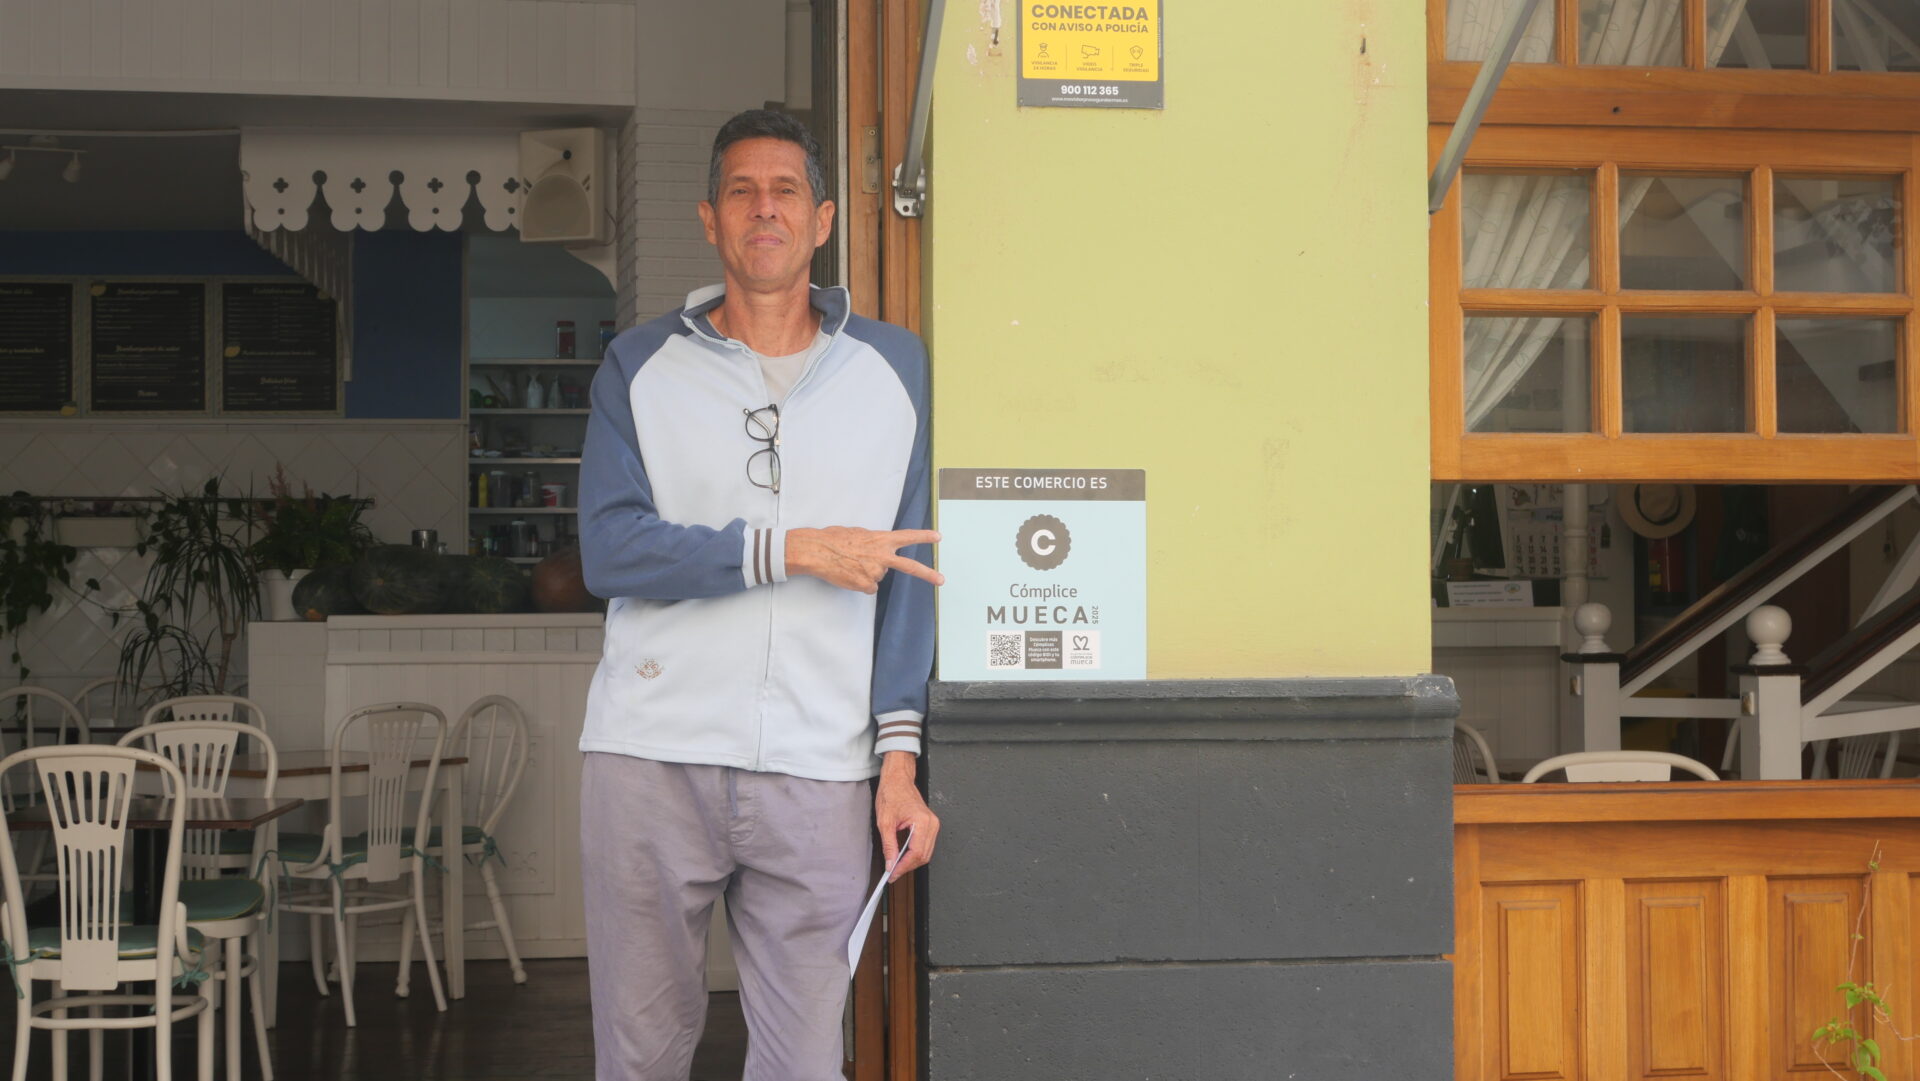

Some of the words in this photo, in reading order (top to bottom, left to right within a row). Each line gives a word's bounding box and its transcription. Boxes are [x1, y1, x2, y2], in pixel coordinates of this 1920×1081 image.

[1031, 4, 1149, 21] CONECTADA
[1031, 22, 1057, 31] CON
[1058, 22, 1093, 32] AVISO
[1095, 23, 1103, 32] A
[1105, 22, 1149, 33] POLICÍA
[1061, 85, 1081, 95] 900
[1083, 85, 1097, 95] 112
[1099, 86, 1119, 96] 365
[976, 476, 1010, 489] ESTE
[1014, 477, 1086, 489] COMERCIO
[1090, 477, 1108, 489] ES
[1030, 529, 1056, 556] C
[1009, 583, 1078, 602] Cómplice
[987, 605, 1089, 624] MUECA
[1091, 605, 1099, 625] 2025
